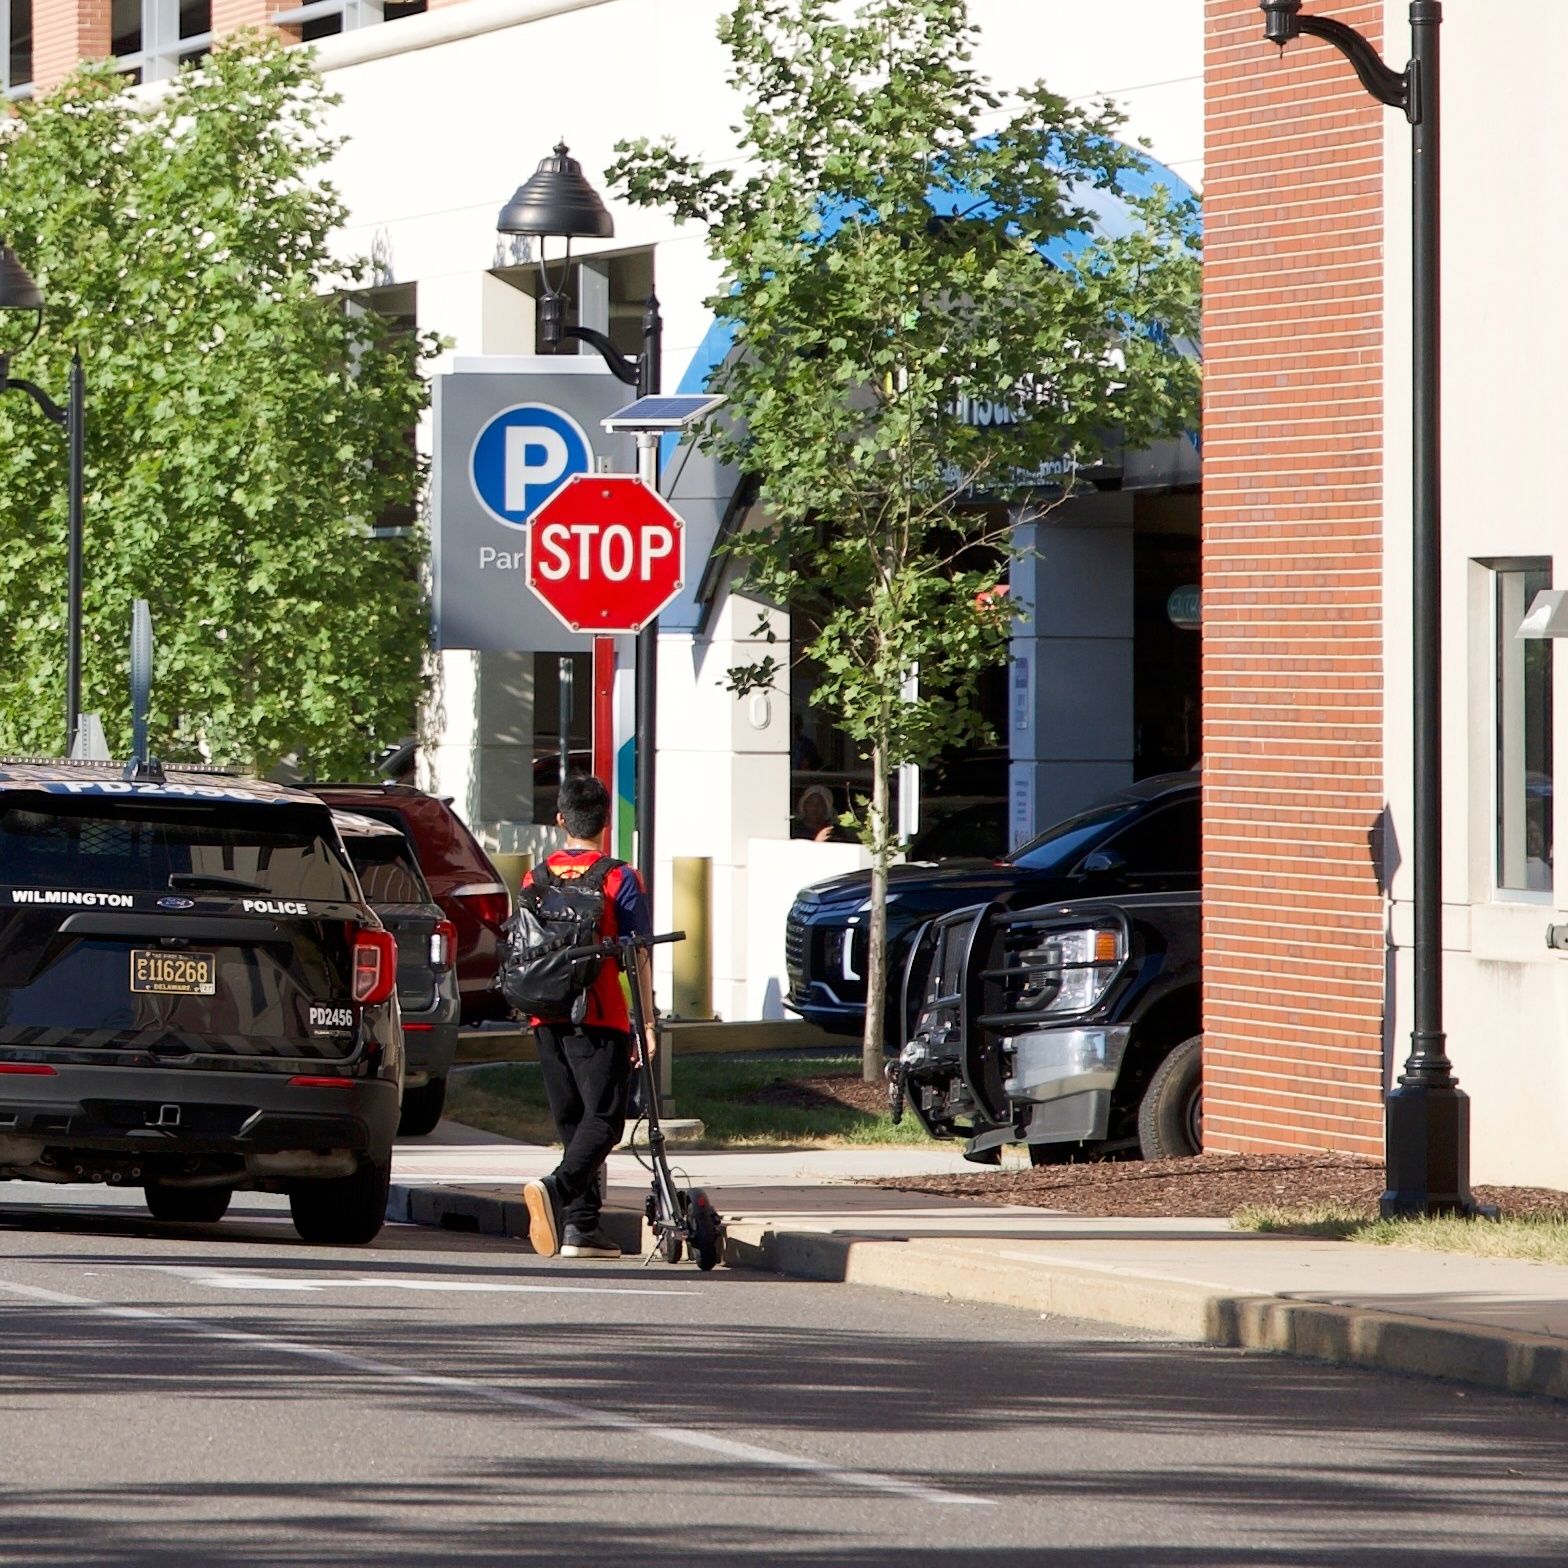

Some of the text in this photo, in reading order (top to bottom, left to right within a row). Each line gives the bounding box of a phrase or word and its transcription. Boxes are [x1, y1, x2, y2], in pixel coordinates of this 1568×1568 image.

[504, 425, 569, 512] P
[538, 522, 674, 582] STOP
[11, 890, 309, 916] WILMINGTON POLICE
[309, 1007, 353, 1027] PD2456
